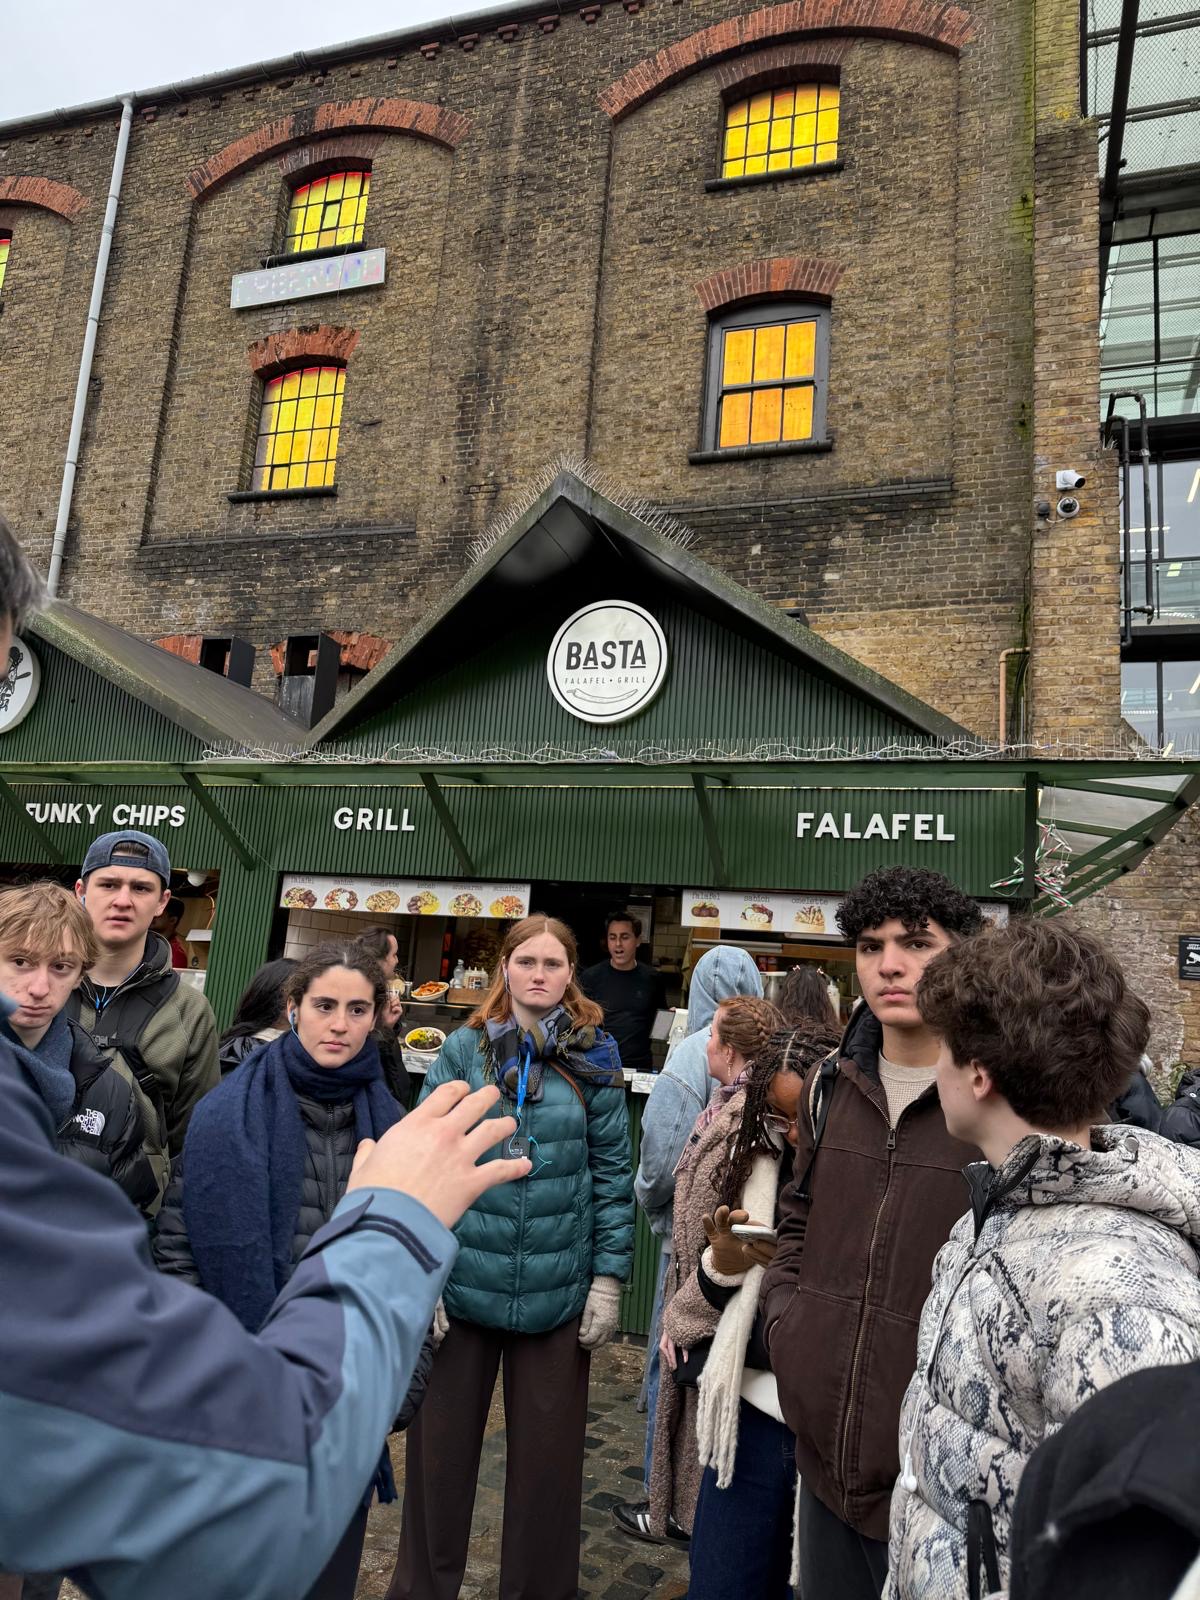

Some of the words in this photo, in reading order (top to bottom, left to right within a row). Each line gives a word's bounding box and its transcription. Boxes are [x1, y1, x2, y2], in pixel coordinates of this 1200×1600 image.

[566, 640, 646, 670] BASTA
[565, 677, 605, 685] FALAFEL
[112, 804, 186, 827] CHIPS
[334, 807, 415, 831] GRILL
[796, 813, 955, 841] FALAFEL
[85, 1108, 98, 1119] THE
